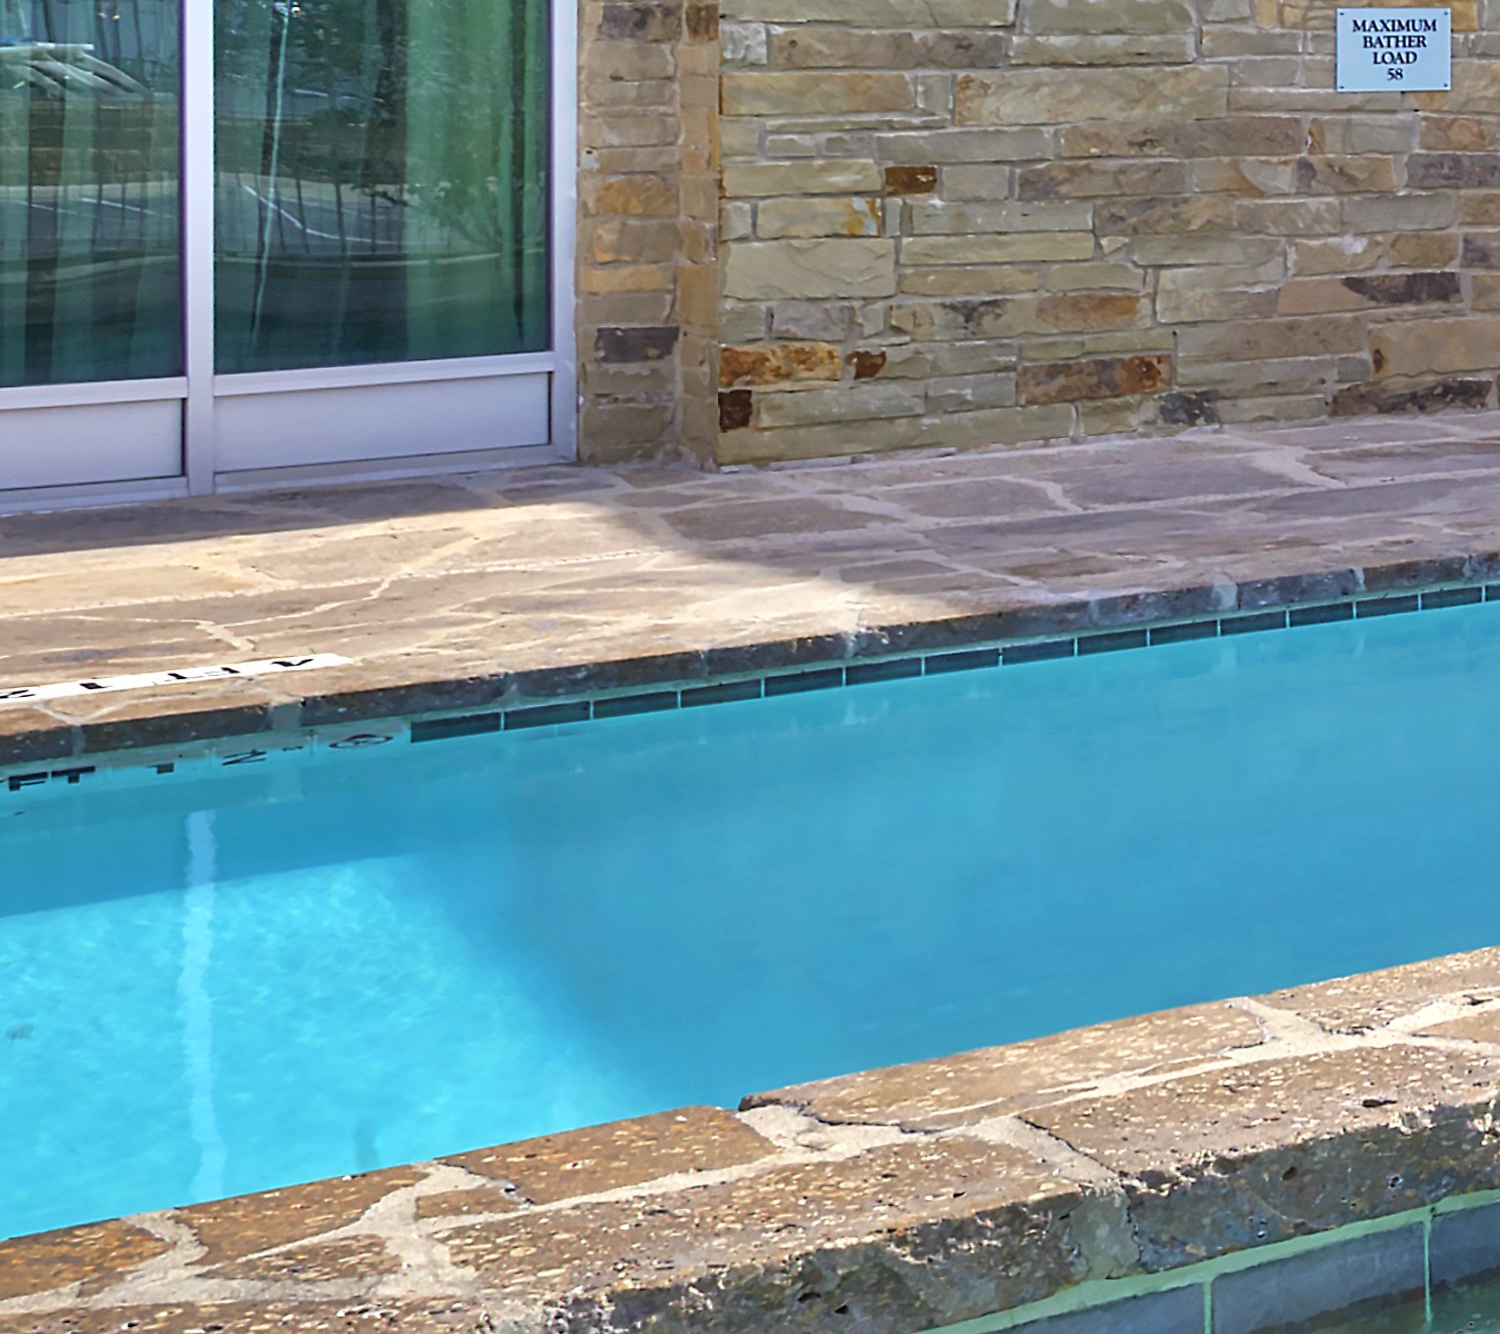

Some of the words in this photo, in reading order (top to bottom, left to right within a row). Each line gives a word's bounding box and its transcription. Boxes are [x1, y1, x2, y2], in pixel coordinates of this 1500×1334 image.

[1352, 19, 1437, 33] MAXIMUM
[1363, 35, 1427, 48] BATHER
[1373, 51, 1418, 64] LOAD
[1387, 68, 1404, 81] 58
